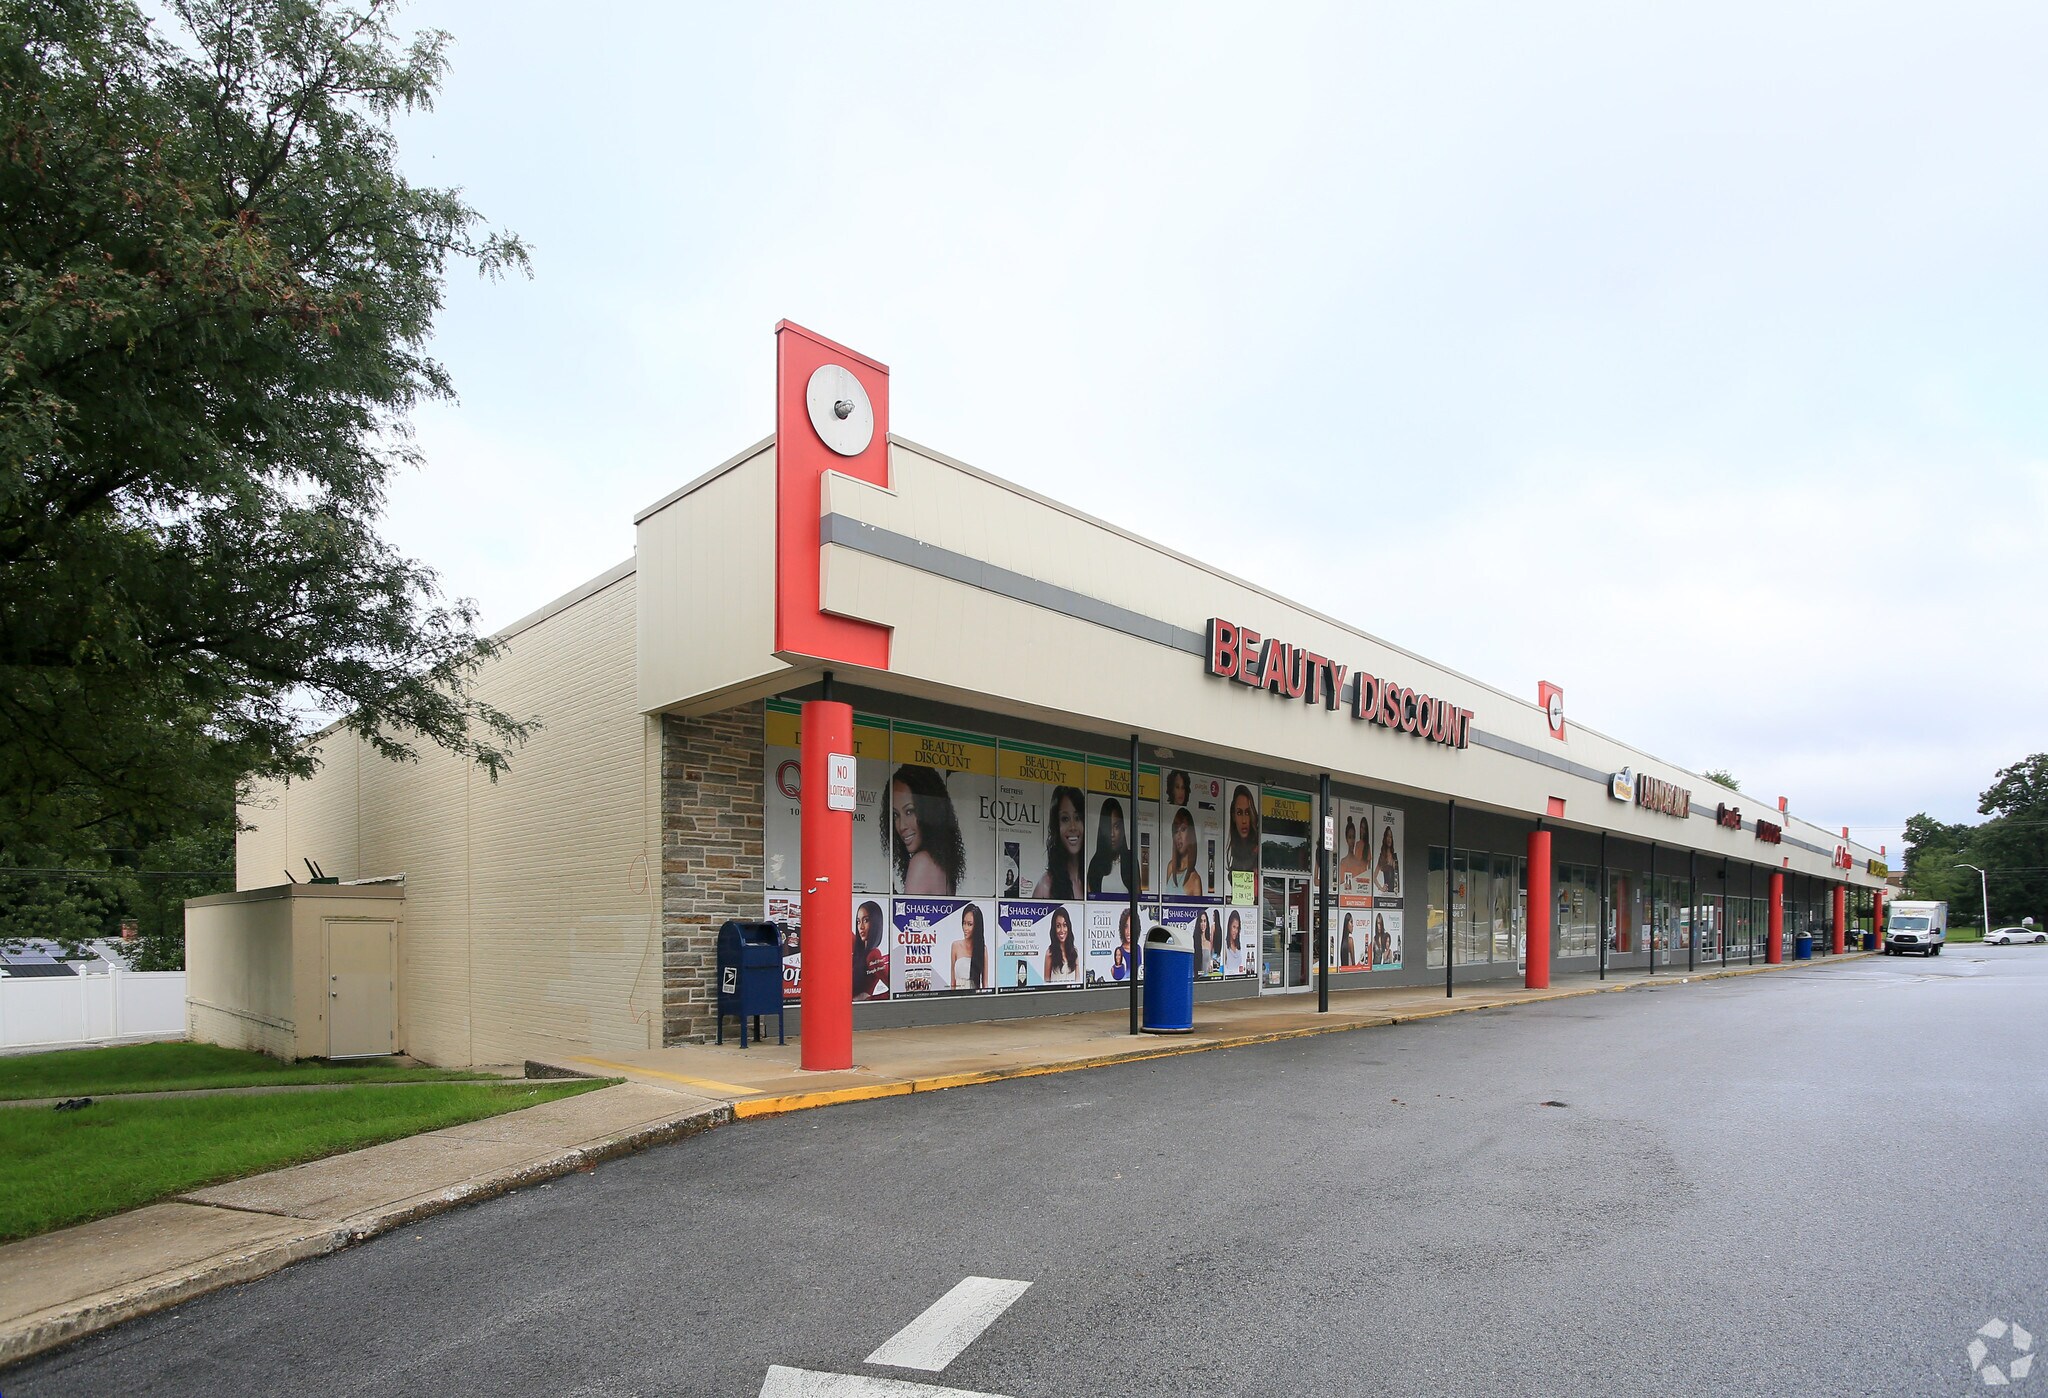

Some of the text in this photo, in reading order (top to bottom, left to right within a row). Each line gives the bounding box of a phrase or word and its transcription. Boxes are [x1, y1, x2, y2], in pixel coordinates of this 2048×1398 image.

[1206, 617, 1475, 749] BEAUTY DISCOUNT
[921, 738, 964, 756] BEAUTY
[915, 750, 971, 769] DISCOUNT
[1025, 756, 1062, 771] BEAUTY
[837, 765, 848, 779] NO
[1019, 766, 1066, 783] DISCOUNT
[830, 785, 855, 798] LOITERING
[1274, 799, 1296, 810] BEAUTY
[979, 796, 1040, 826] EQUAL
[906, 904, 952, 914] SHAKE-N-GO
[1009, 907, 1047, 915] SHAKE-N-GO
[1168, 910, 1198, 918] SHAKE-N-GO
[1093, 914, 1111, 926] rain
[898, 931, 937, 944] CUBAN
[1088, 929, 1116, 938] INDIAN
[906, 945, 931, 955] TWIST
[1092, 939, 1111, 949] REMY
[905, 956, 932, 964] BRAID
